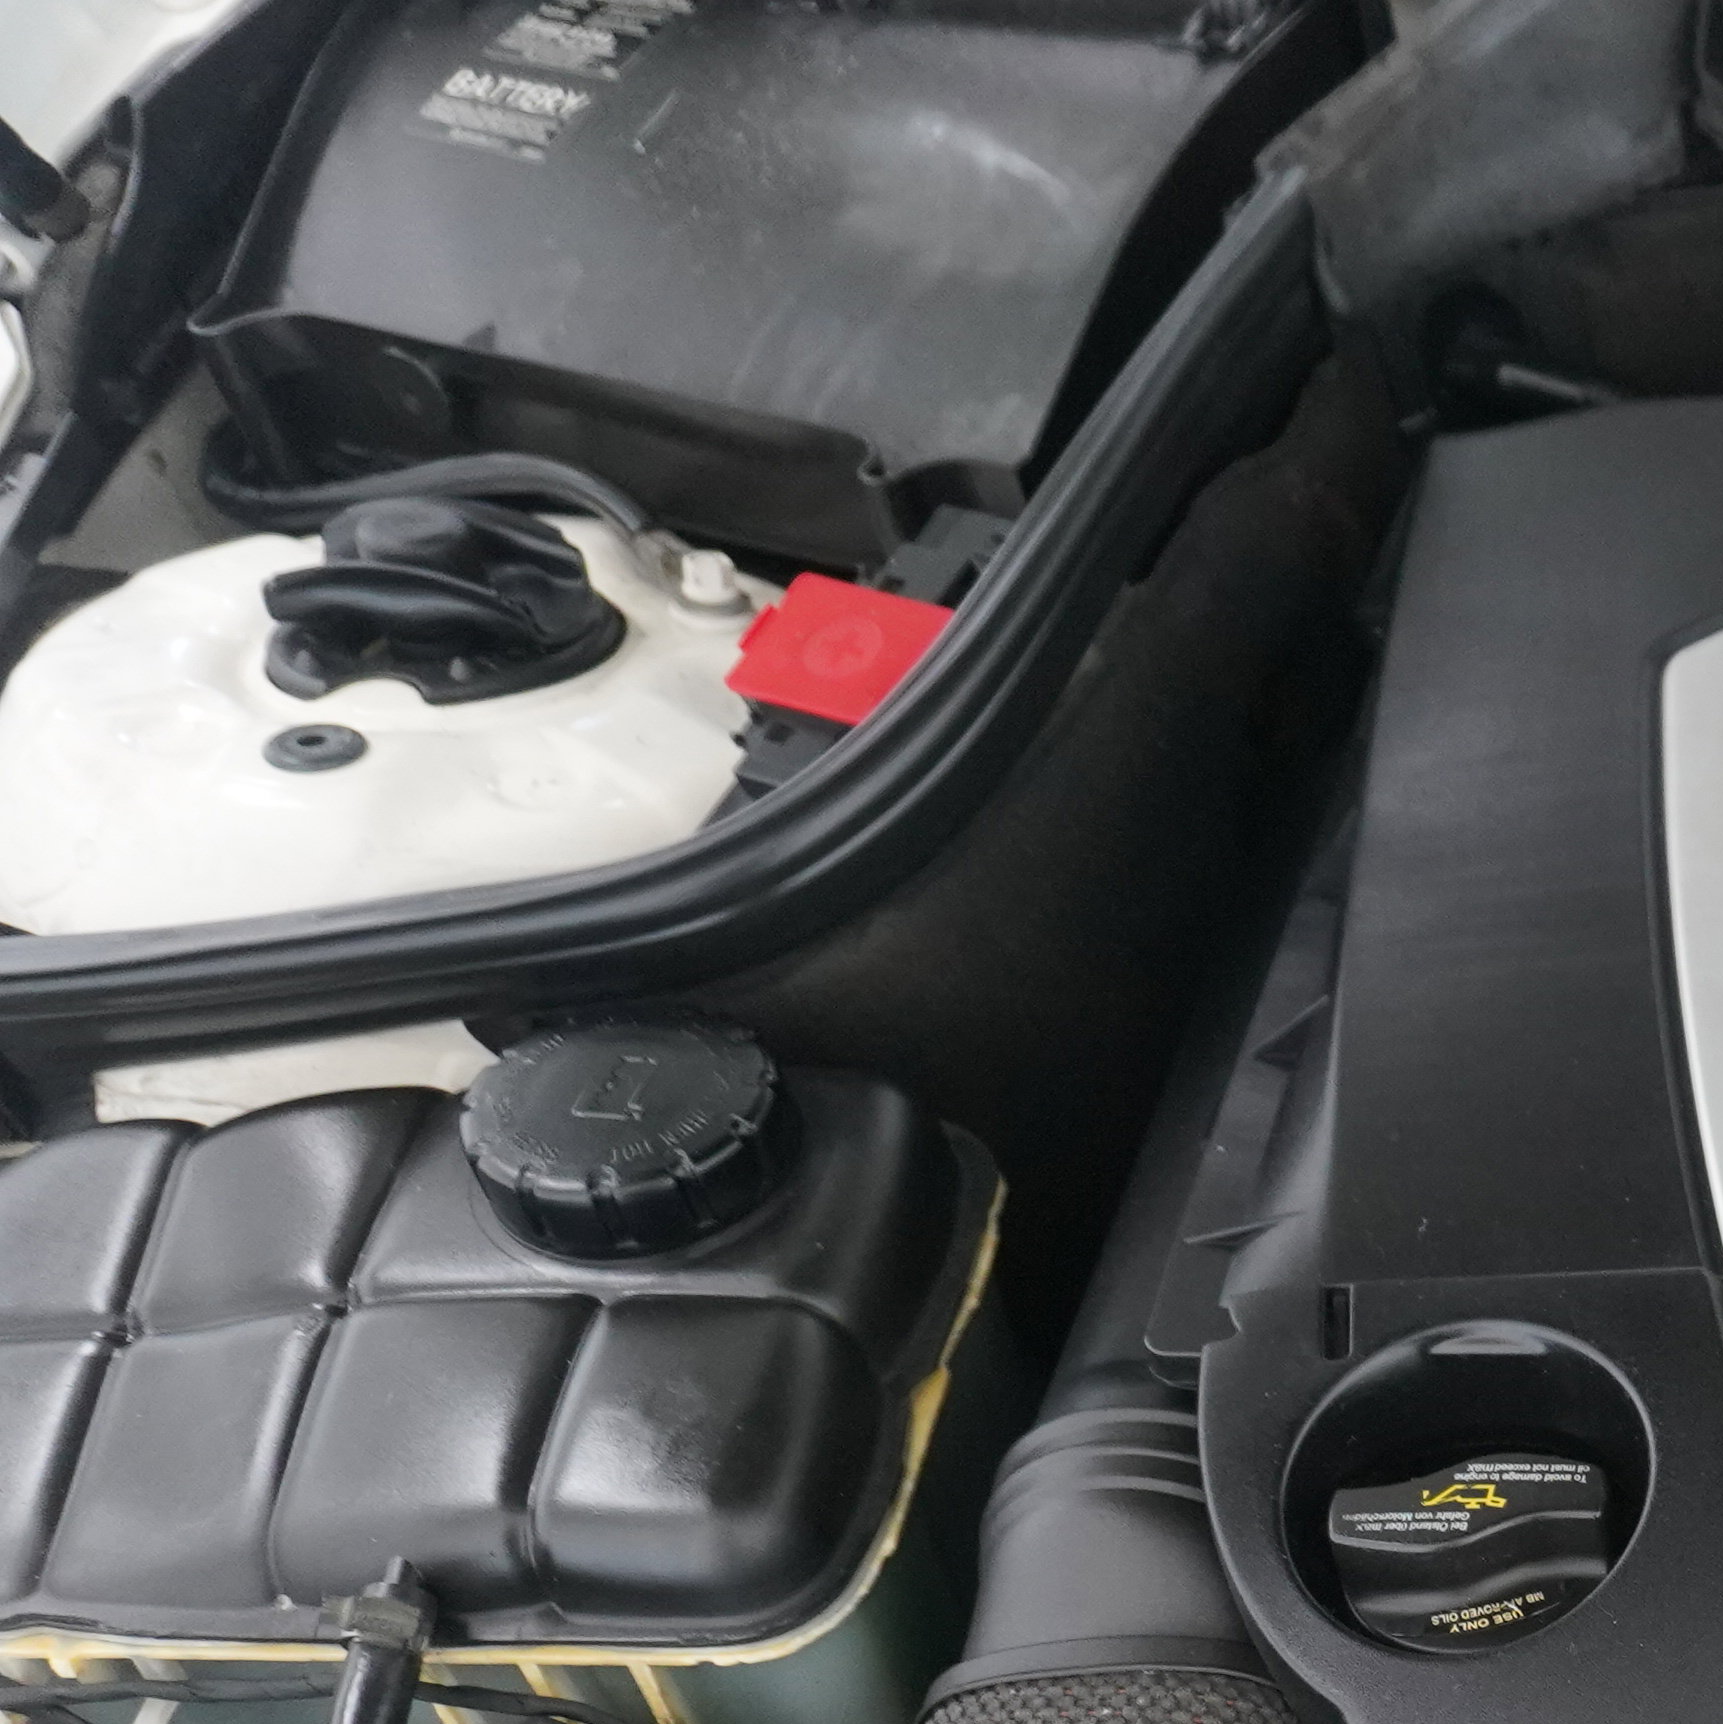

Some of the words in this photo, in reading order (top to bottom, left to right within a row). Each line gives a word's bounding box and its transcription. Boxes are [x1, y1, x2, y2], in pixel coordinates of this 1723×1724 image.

[442, 66, 591, 120] BATTERY
[1494, 1463, 1531, 1472] exceed
[1532, 1463, 1549, 1472] not
[1502, 1472, 1543, 1482] damage
[1544, 1473, 1572, 1482] avoid
[1574, 1474, 1587, 1484] To
[1414, 1512, 1434, 1520] von
[1525, 1590, 1545, 1604] MB
[1431, 1612, 1459, 1626] OILS
[1492, 1609, 1524, 1625] USE
[1449, 1617, 1490, 1634] ONLY
